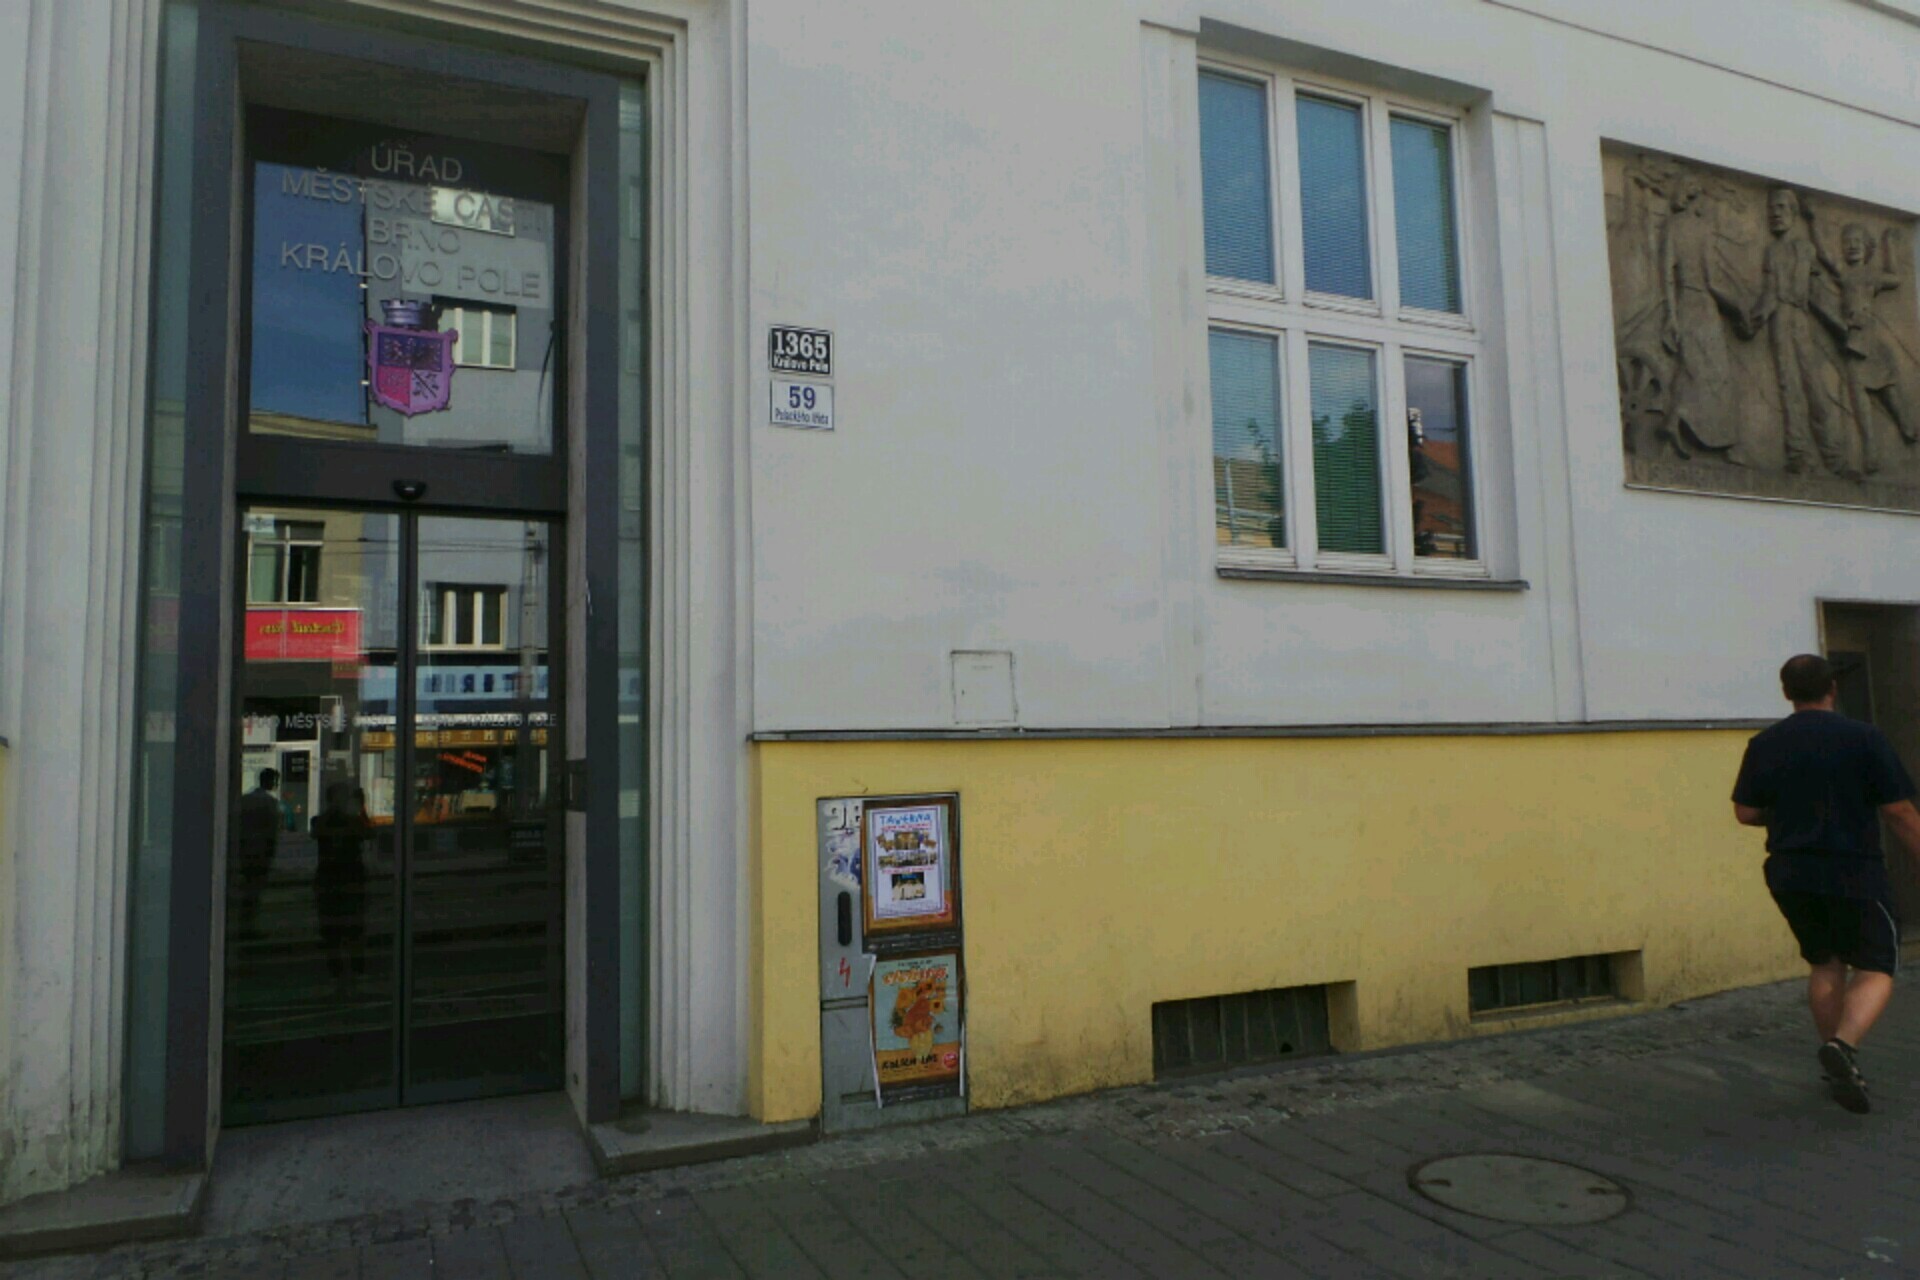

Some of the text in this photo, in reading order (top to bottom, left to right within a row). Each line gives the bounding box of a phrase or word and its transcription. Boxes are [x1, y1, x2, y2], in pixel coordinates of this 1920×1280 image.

[370, 142, 463, 183] ÚŘAD
[281, 166, 438, 219] MĚSTSKÉ
[368, 218, 462, 255] BRNO
[280, 241, 541, 299] KRÁLOVO POLE
[774, 331, 827, 359] 1365
[789, 386, 815, 410] 59
